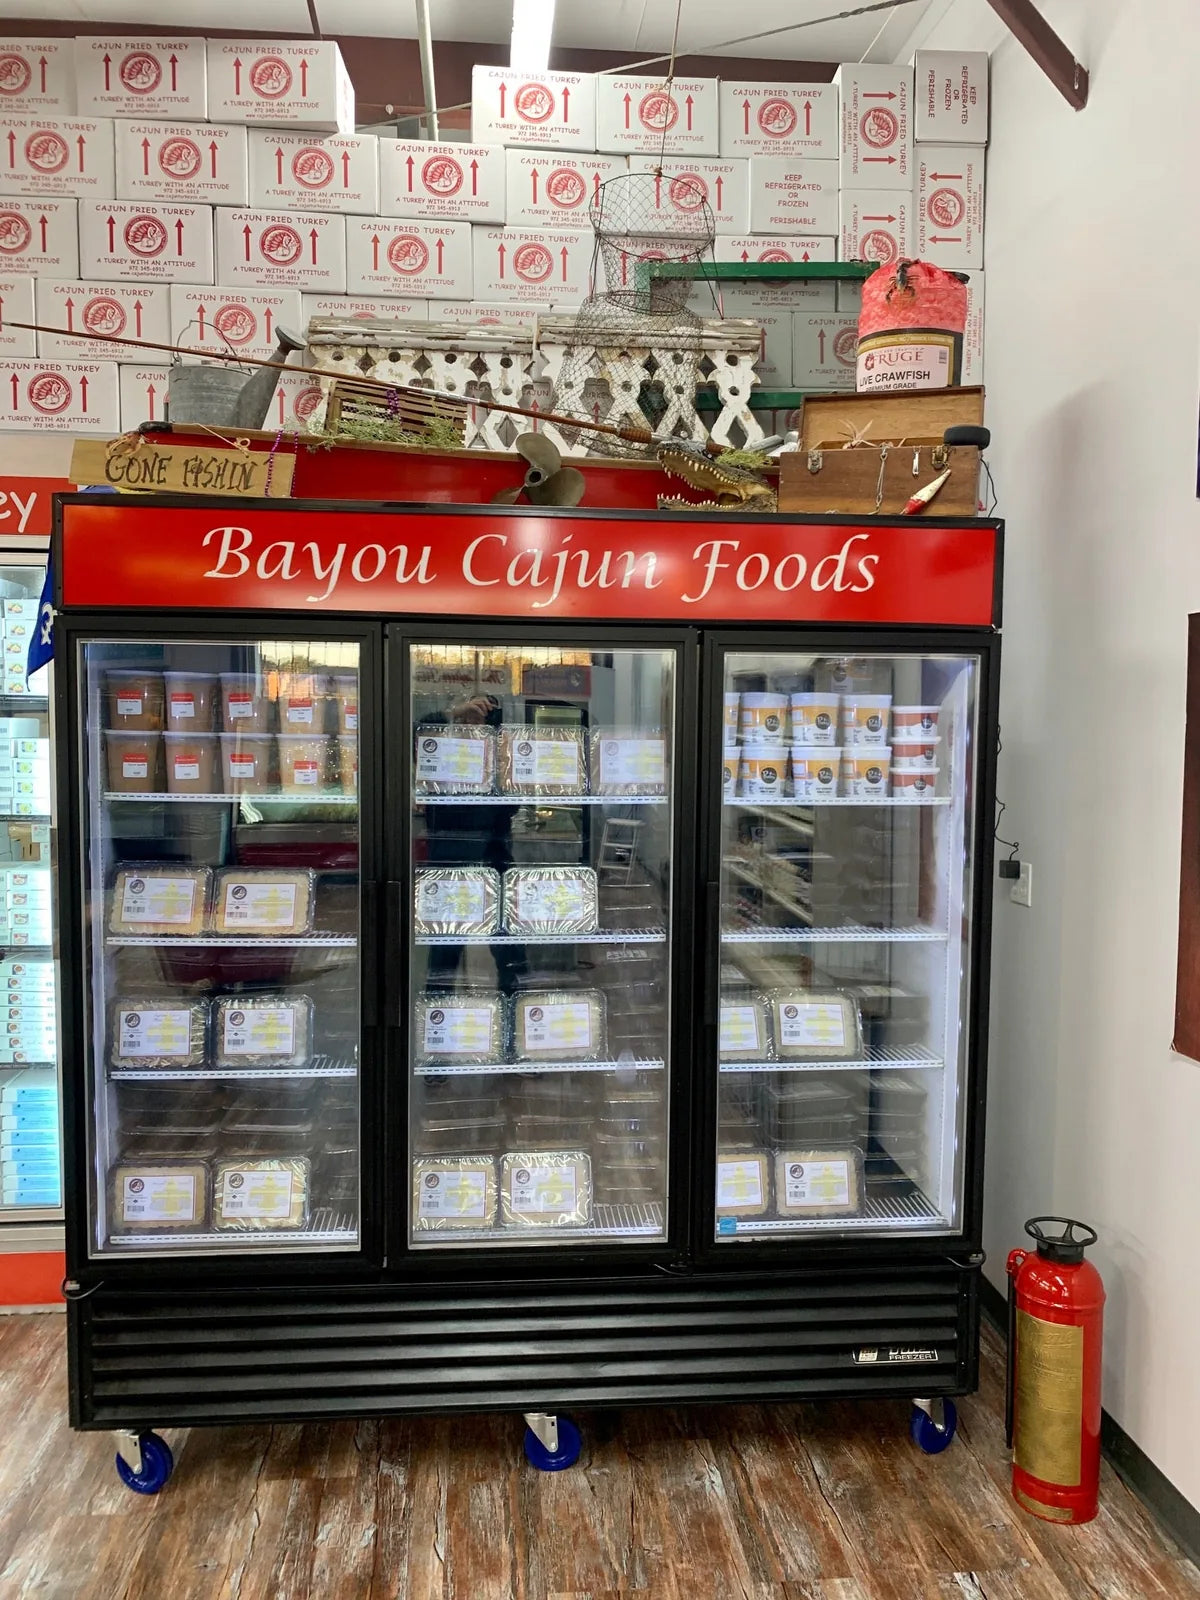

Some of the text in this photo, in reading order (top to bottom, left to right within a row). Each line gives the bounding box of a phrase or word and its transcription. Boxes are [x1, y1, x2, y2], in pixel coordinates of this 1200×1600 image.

[256, 46, 282, 54] FRIED
[286, 47, 319, 55] TURKEY
[488, 70, 580, 84] CAJUN FRIED TURKEY
[954, 89, 960, 100] OR
[961, 66, 969, 124] REFRIGERATED
[30, 120, 96, 131] FRIED TURKEY
[130, 125, 228, 137] CAJUN FRIED TURKEY
[264, 135, 360, 148] CAJUN FRIED TURKEY
[854, 133, 858, 141] AN
[396, 144, 489, 156] CAJUN FRIED TURKEY
[521, 157, 611, 169] CAJUN FRIED TURKEY
[765, 183, 821, 191] REFRIGERATED
[967, 196, 971, 204] AN
[26, 203, 60, 212] TURKEY
[95, 204, 126, 212] CAJUN
[161, 207, 195, 215] TURKEY
[232, 213, 328, 225] CAJUN FRIED TURKEY
[770, 217, 816, 225] PERISHABLE
[393, 225, 419, 233] FRIED
[423, 226, 455, 235] TURKEY
[519, 233, 544, 241] FRIED
[548, 235, 579, 243] TURKEY
[88, 287, 115, 295] FRIED
[120, 288, 153, 296] TURKEY
[250, 296, 283, 304] TURKEY
[317, 302, 347, 310] CAJUN
[34, 363, 62, 371] FRIED
[66, 364, 100, 372] TURKEY
[860, 371, 930, 387] LIVE CRAWFISH
[105, 453, 173, 484] GONE
[202, 526, 880, 609] Bayou Cajun Foods
